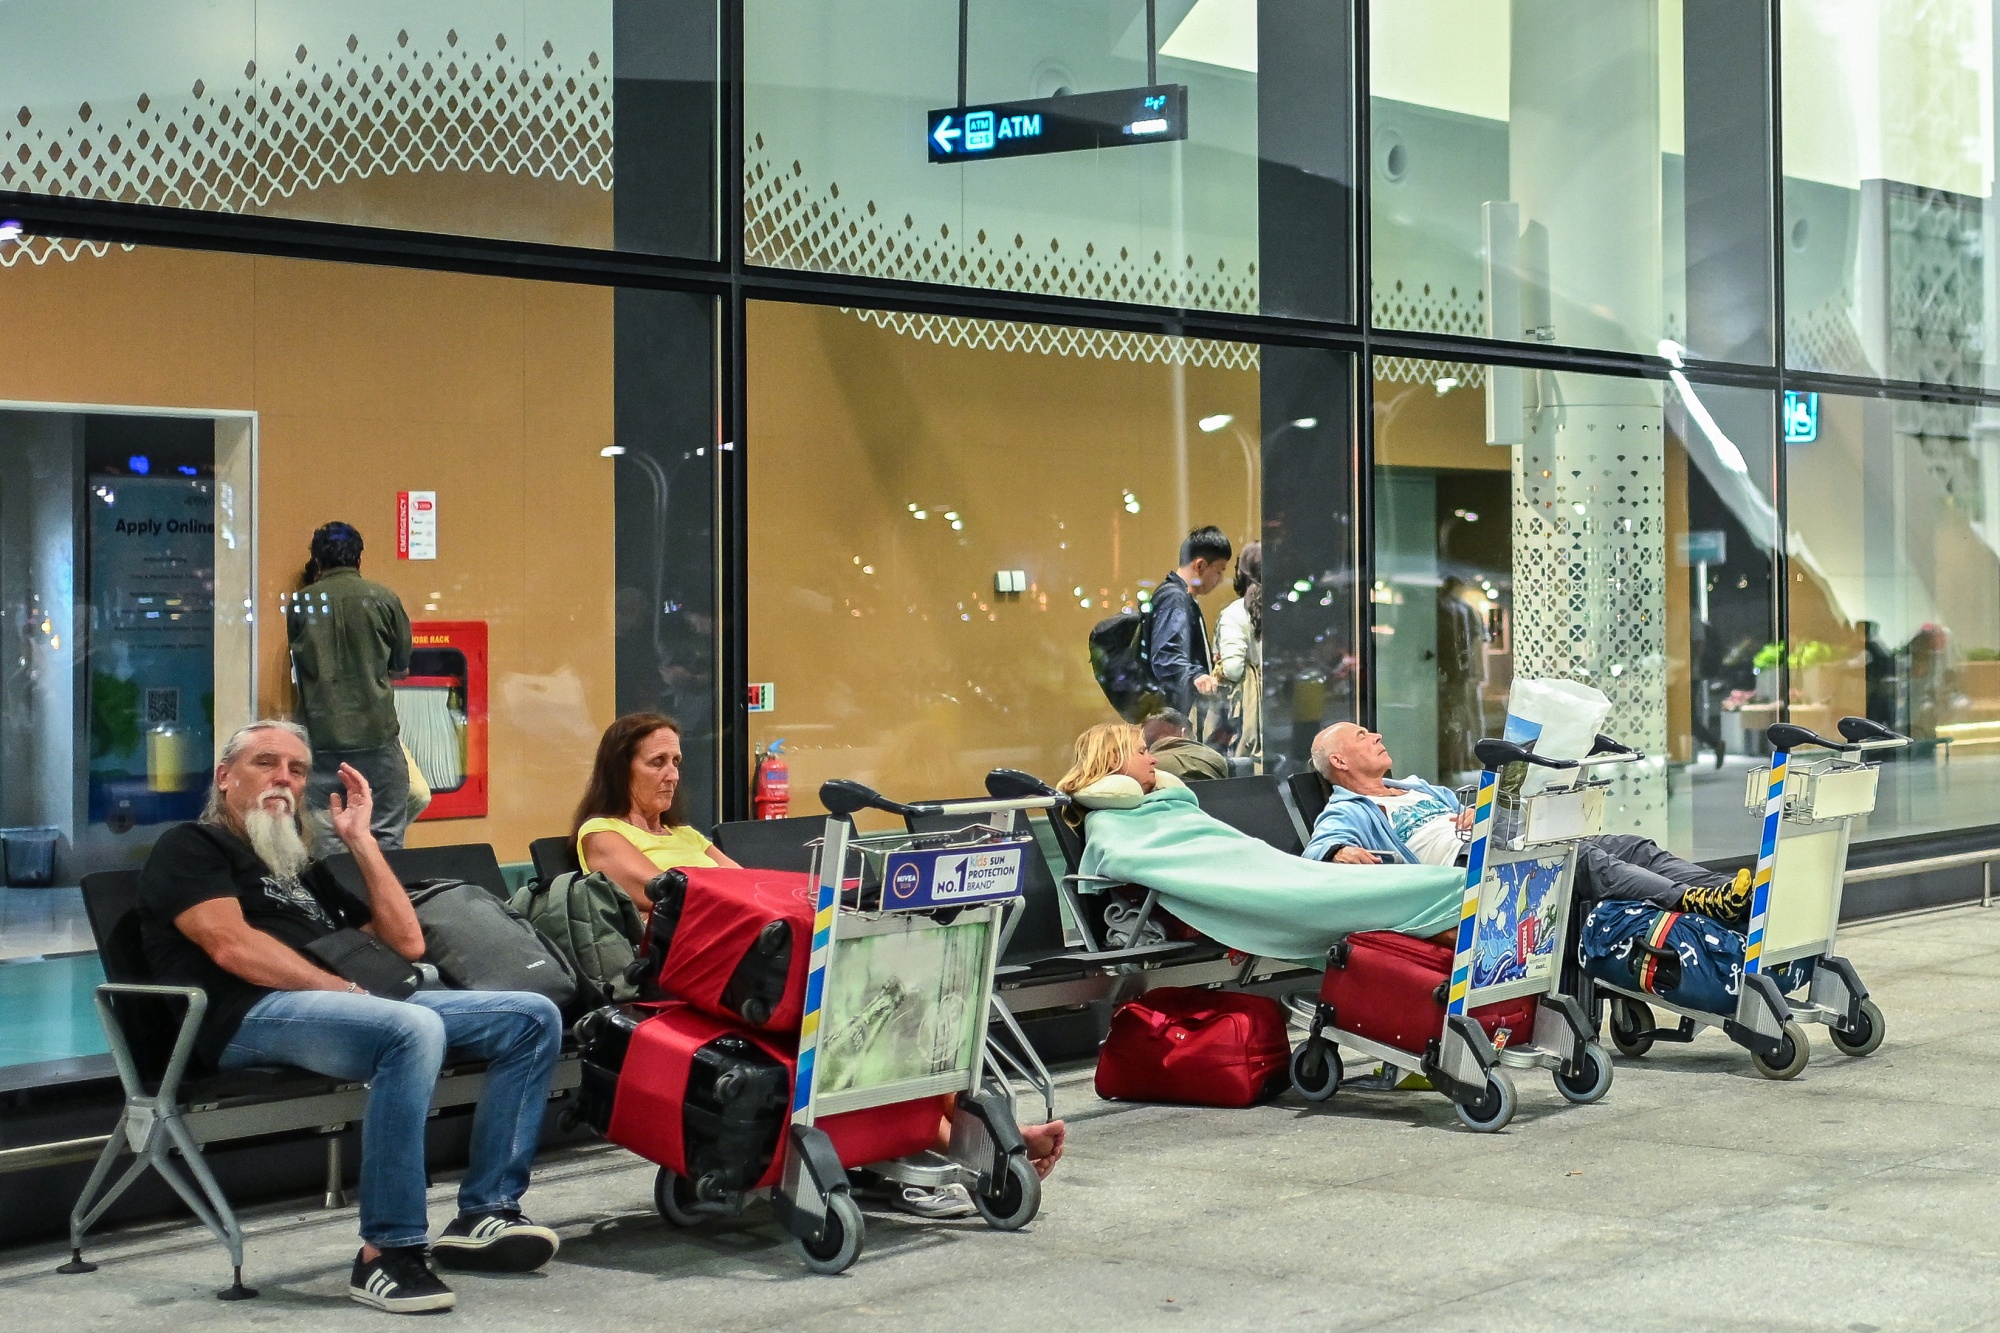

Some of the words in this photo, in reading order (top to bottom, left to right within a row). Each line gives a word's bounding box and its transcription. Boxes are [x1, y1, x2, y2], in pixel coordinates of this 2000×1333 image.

[970, 119, 989, 131] ATM
[998, 114, 1040, 138] ATM
[115, 518, 162, 536] Apply
[166, 517, 214, 534] Online
[969, 855, 988, 867] kids
[989, 856, 1006, 866] SUN
[896, 874, 917, 883] NIVEA
[968, 866, 1015, 879] PROTECTION
